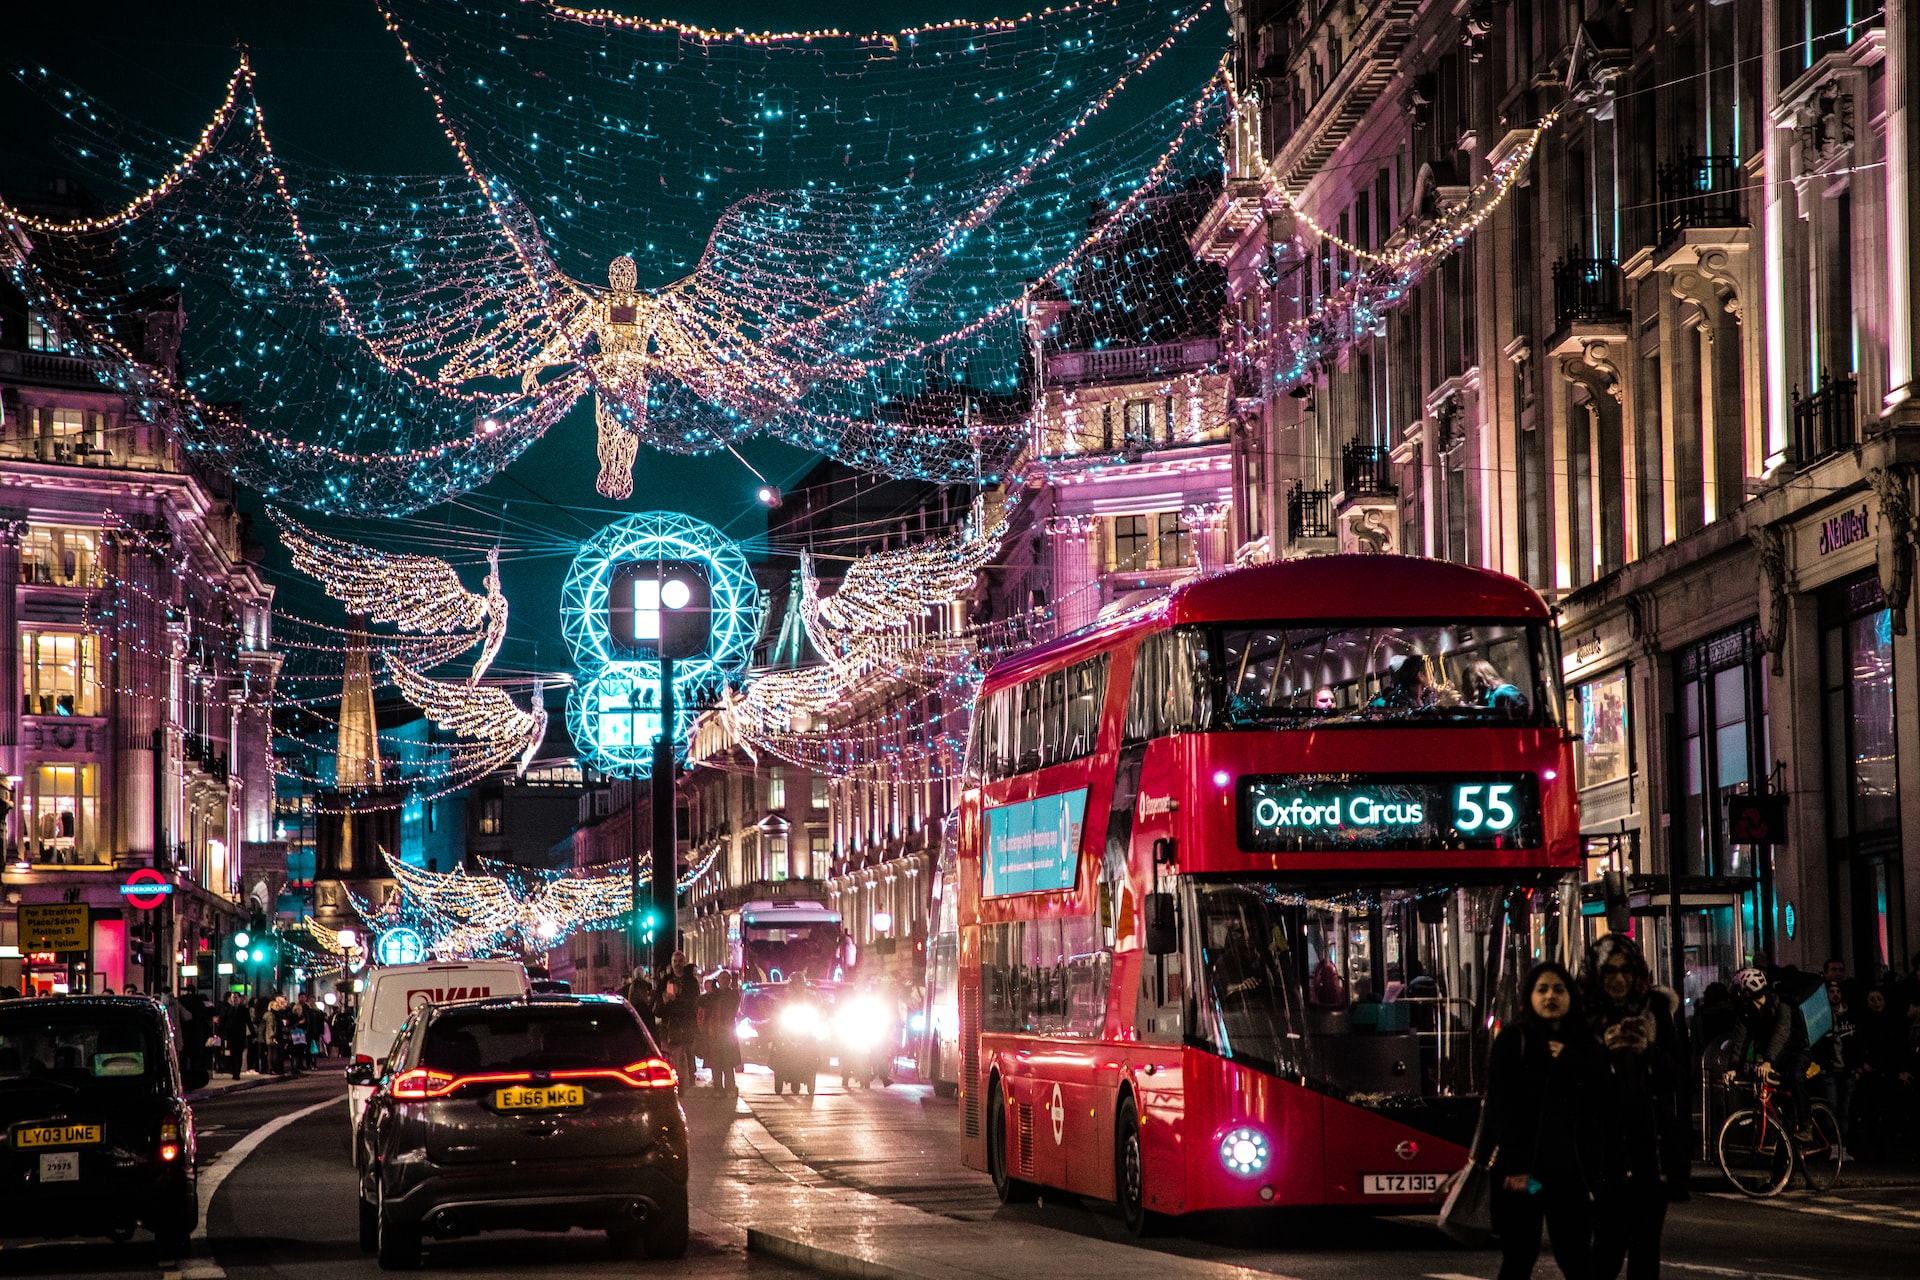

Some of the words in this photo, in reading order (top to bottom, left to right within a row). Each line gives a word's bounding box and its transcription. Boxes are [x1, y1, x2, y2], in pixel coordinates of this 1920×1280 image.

[1826, 504, 1869, 553] NatWest
[1256, 797, 1340, 826] Oxford
[1349, 796, 1423, 824] Circus
[1456, 784, 1514, 830] 55
[25, 909, 38, 917] For
[42, 907, 82, 916] Stratford
[28, 917, 80, 926] Place/South
[54, 939, 80, 948] follow
[503, 1090, 543, 1106] EJ66
[23, 1129, 62, 1144] LY03
[65, 1127, 94, 1141] UNE
[1375, 1176, 1405, 1191] LTZ
[1409, 1176, 1436, 1191] 1313
